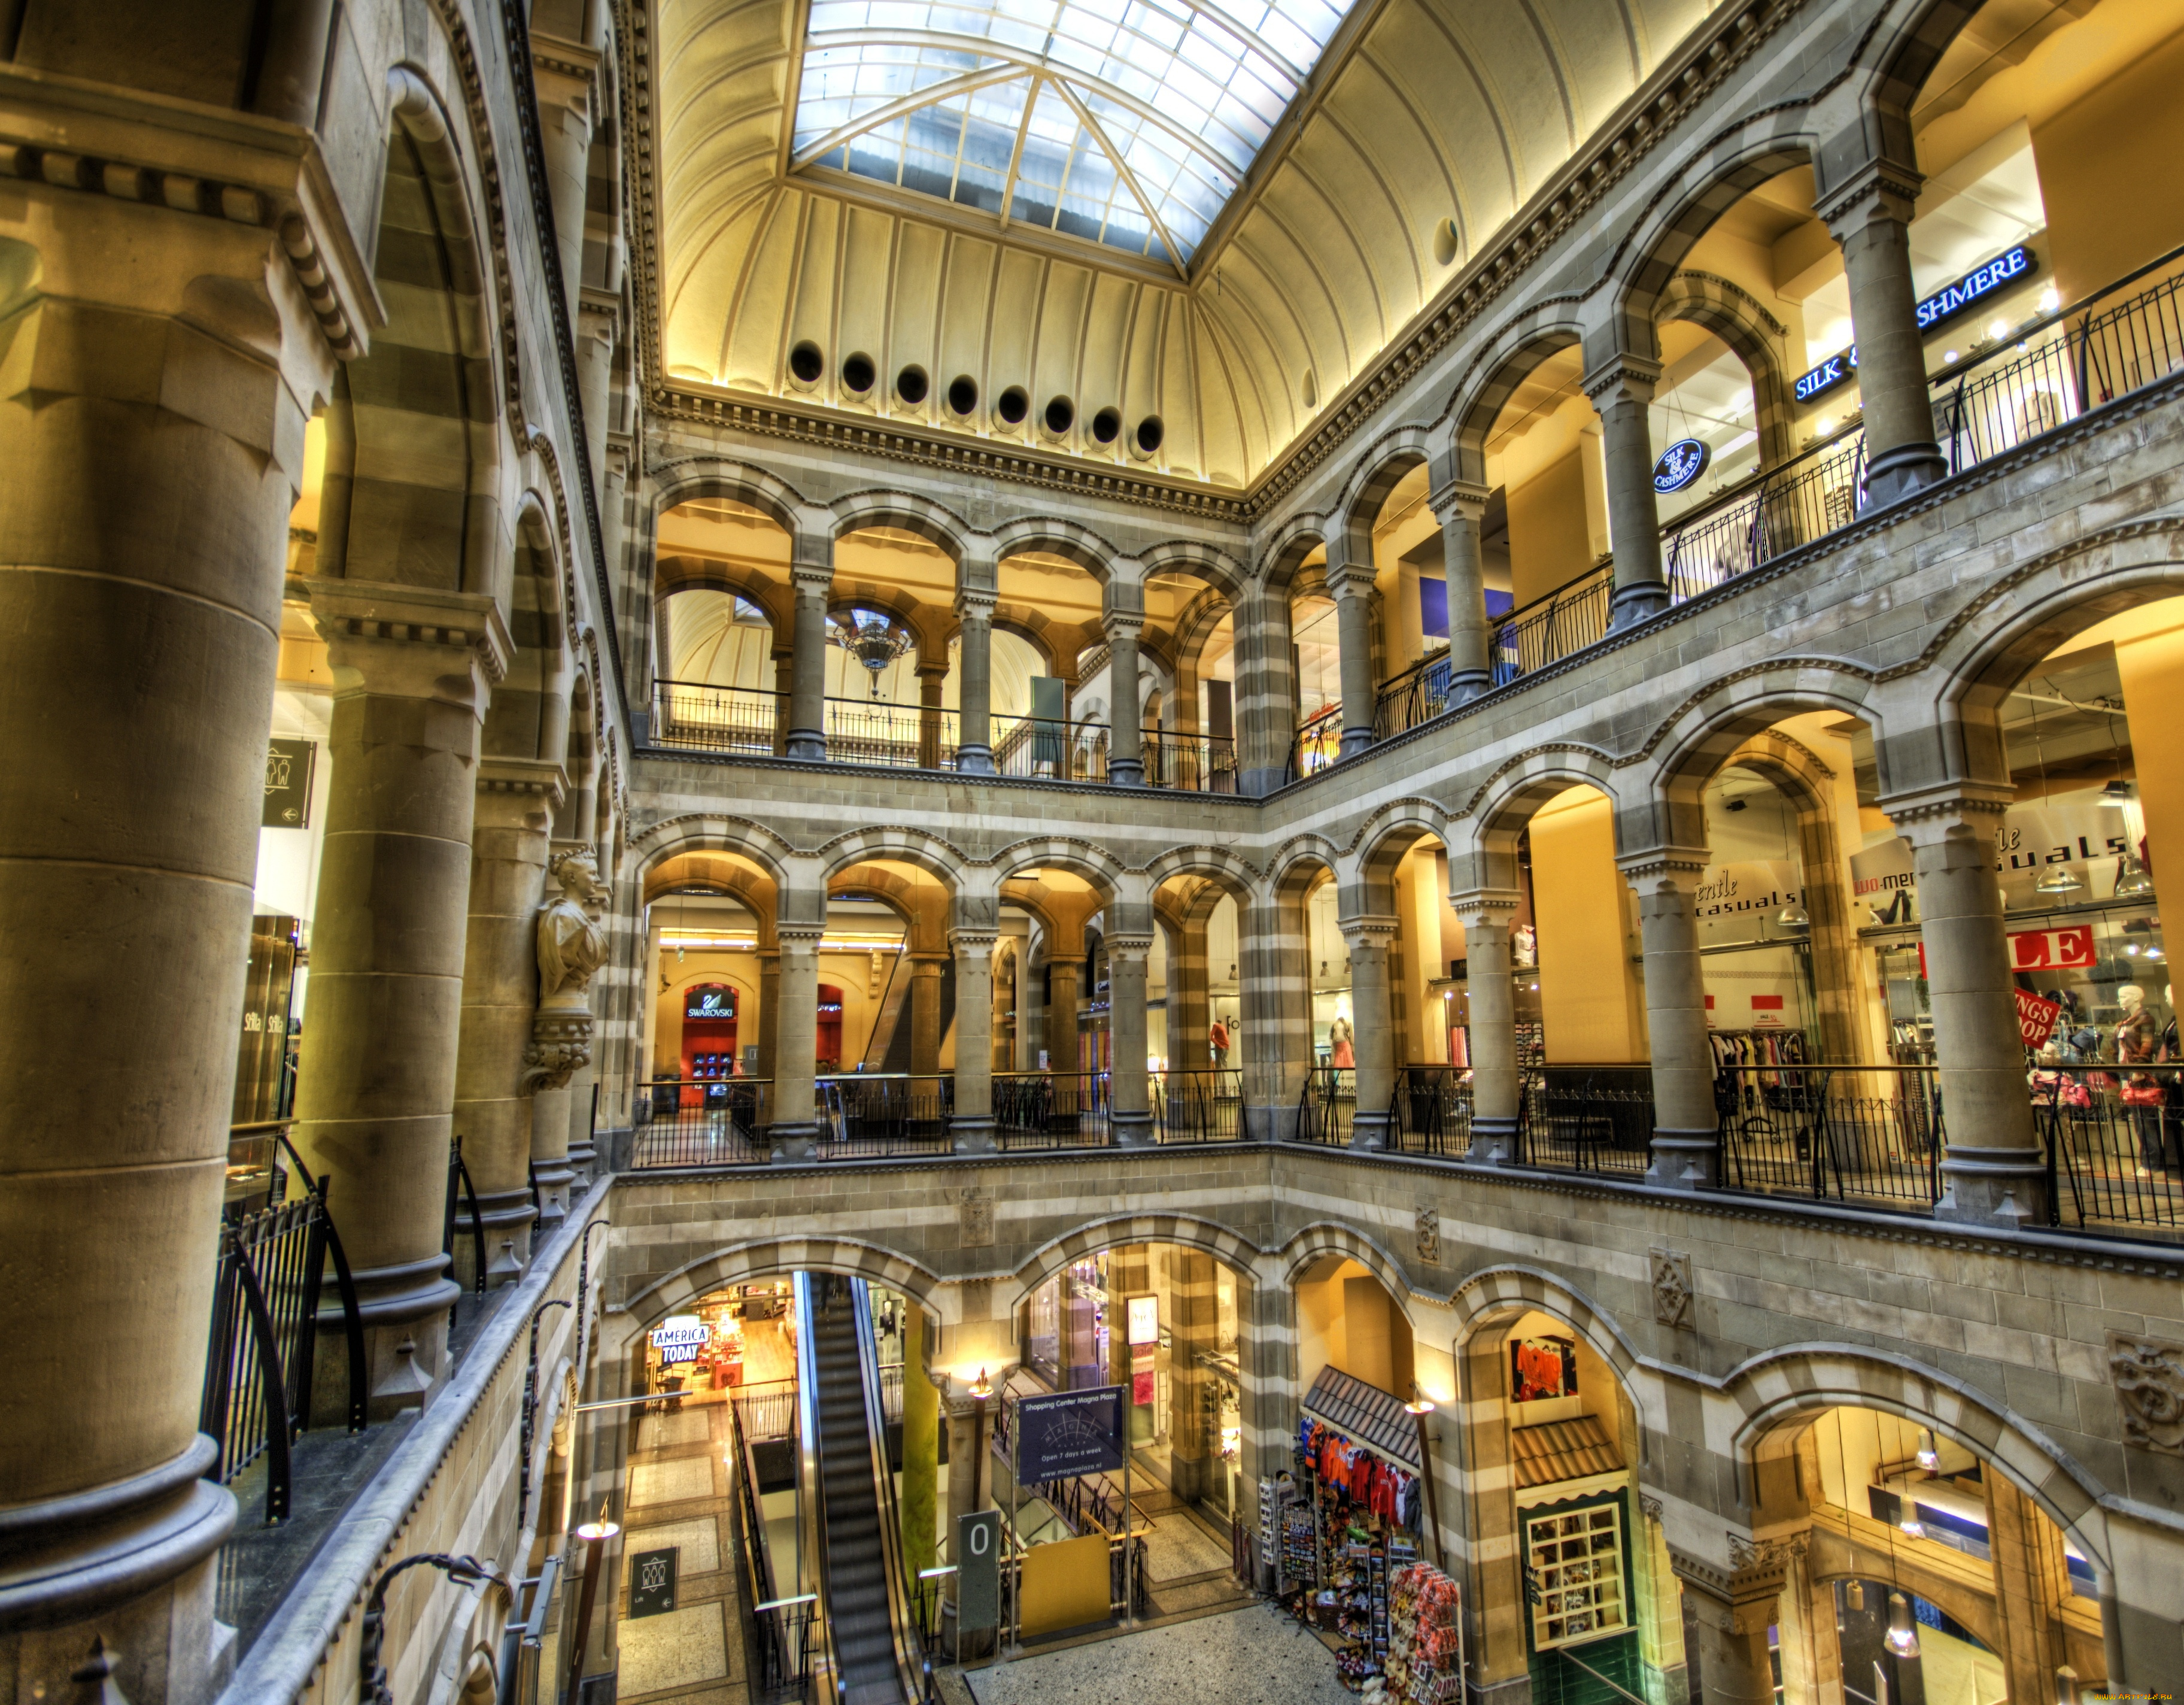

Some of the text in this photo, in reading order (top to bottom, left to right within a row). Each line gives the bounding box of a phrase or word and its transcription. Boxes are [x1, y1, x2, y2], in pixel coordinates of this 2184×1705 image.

[1796, 358, 1841, 399] SILK
[1916, 248, 2026, 327] SHMERE
[1664, 445, 1685, 466] SILK
[1654, 453, 1699, 487] CASHMERE
[1669, 459, 1682, 475] &
[1995, 828, 2020, 851] le
[1694, 869, 1738, 902] entle
[1696, 891, 1796, 917] casuals
[688, 1009, 733, 1017] SWAROVSKI
[2015, 994, 2052, 1024] NGS
[2019, 1016, 2046, 1042] OP
[655, 1328, 705, 1345] AMERICA
[663, 1345, 698, 1362] TODAY
[1025, 1392, 1116, 1412] Shopping Center Magna Plaza
[1045, 1424, 1098, 1443] MAGNA
[1041, 1463, 1102, 1478] www.magnaplaza.nl
[971, 1524, 988, 1555] 0
